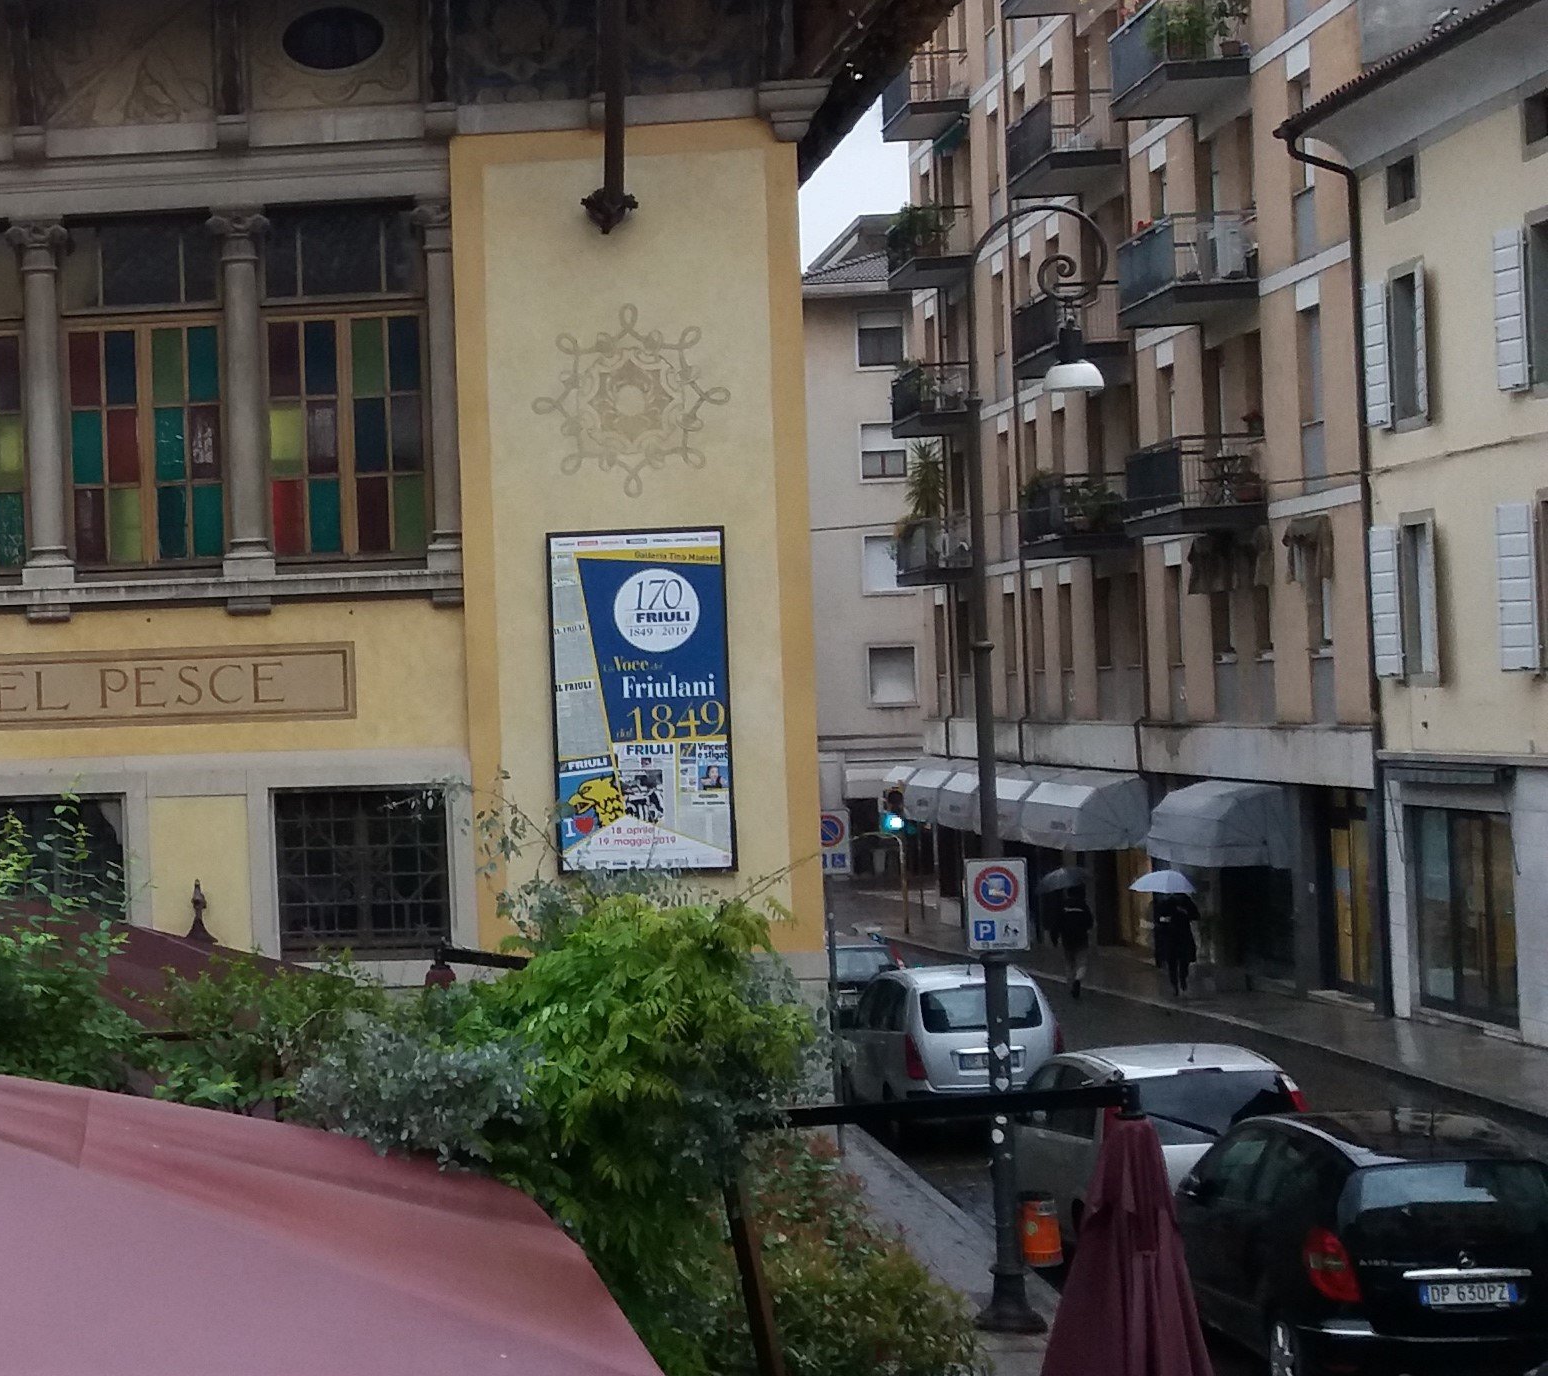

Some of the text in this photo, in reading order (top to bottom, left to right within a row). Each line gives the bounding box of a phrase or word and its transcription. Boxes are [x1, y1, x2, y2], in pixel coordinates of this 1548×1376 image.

[634, 578, 683, 611] 170
[636, 611, 690, 623] FRIULI
[628, 625, 688, 637] 1849 2019
[613, 655, 649, 672] Voce
[98, 661, 286, 709] PESCE
[564, 680, 592, 692] FRIULI
[621, 672, 716, 699] Friulani
[626, 699, 726, 743] 1849
[625, 743, 674, 756] FRIULI
[568, 757, 608, 771] FRIULI
[611, 826, 622, 835] 18
[614, 836, 652, 848] maggio
[1430, 1285, 1450, 1302] DP
